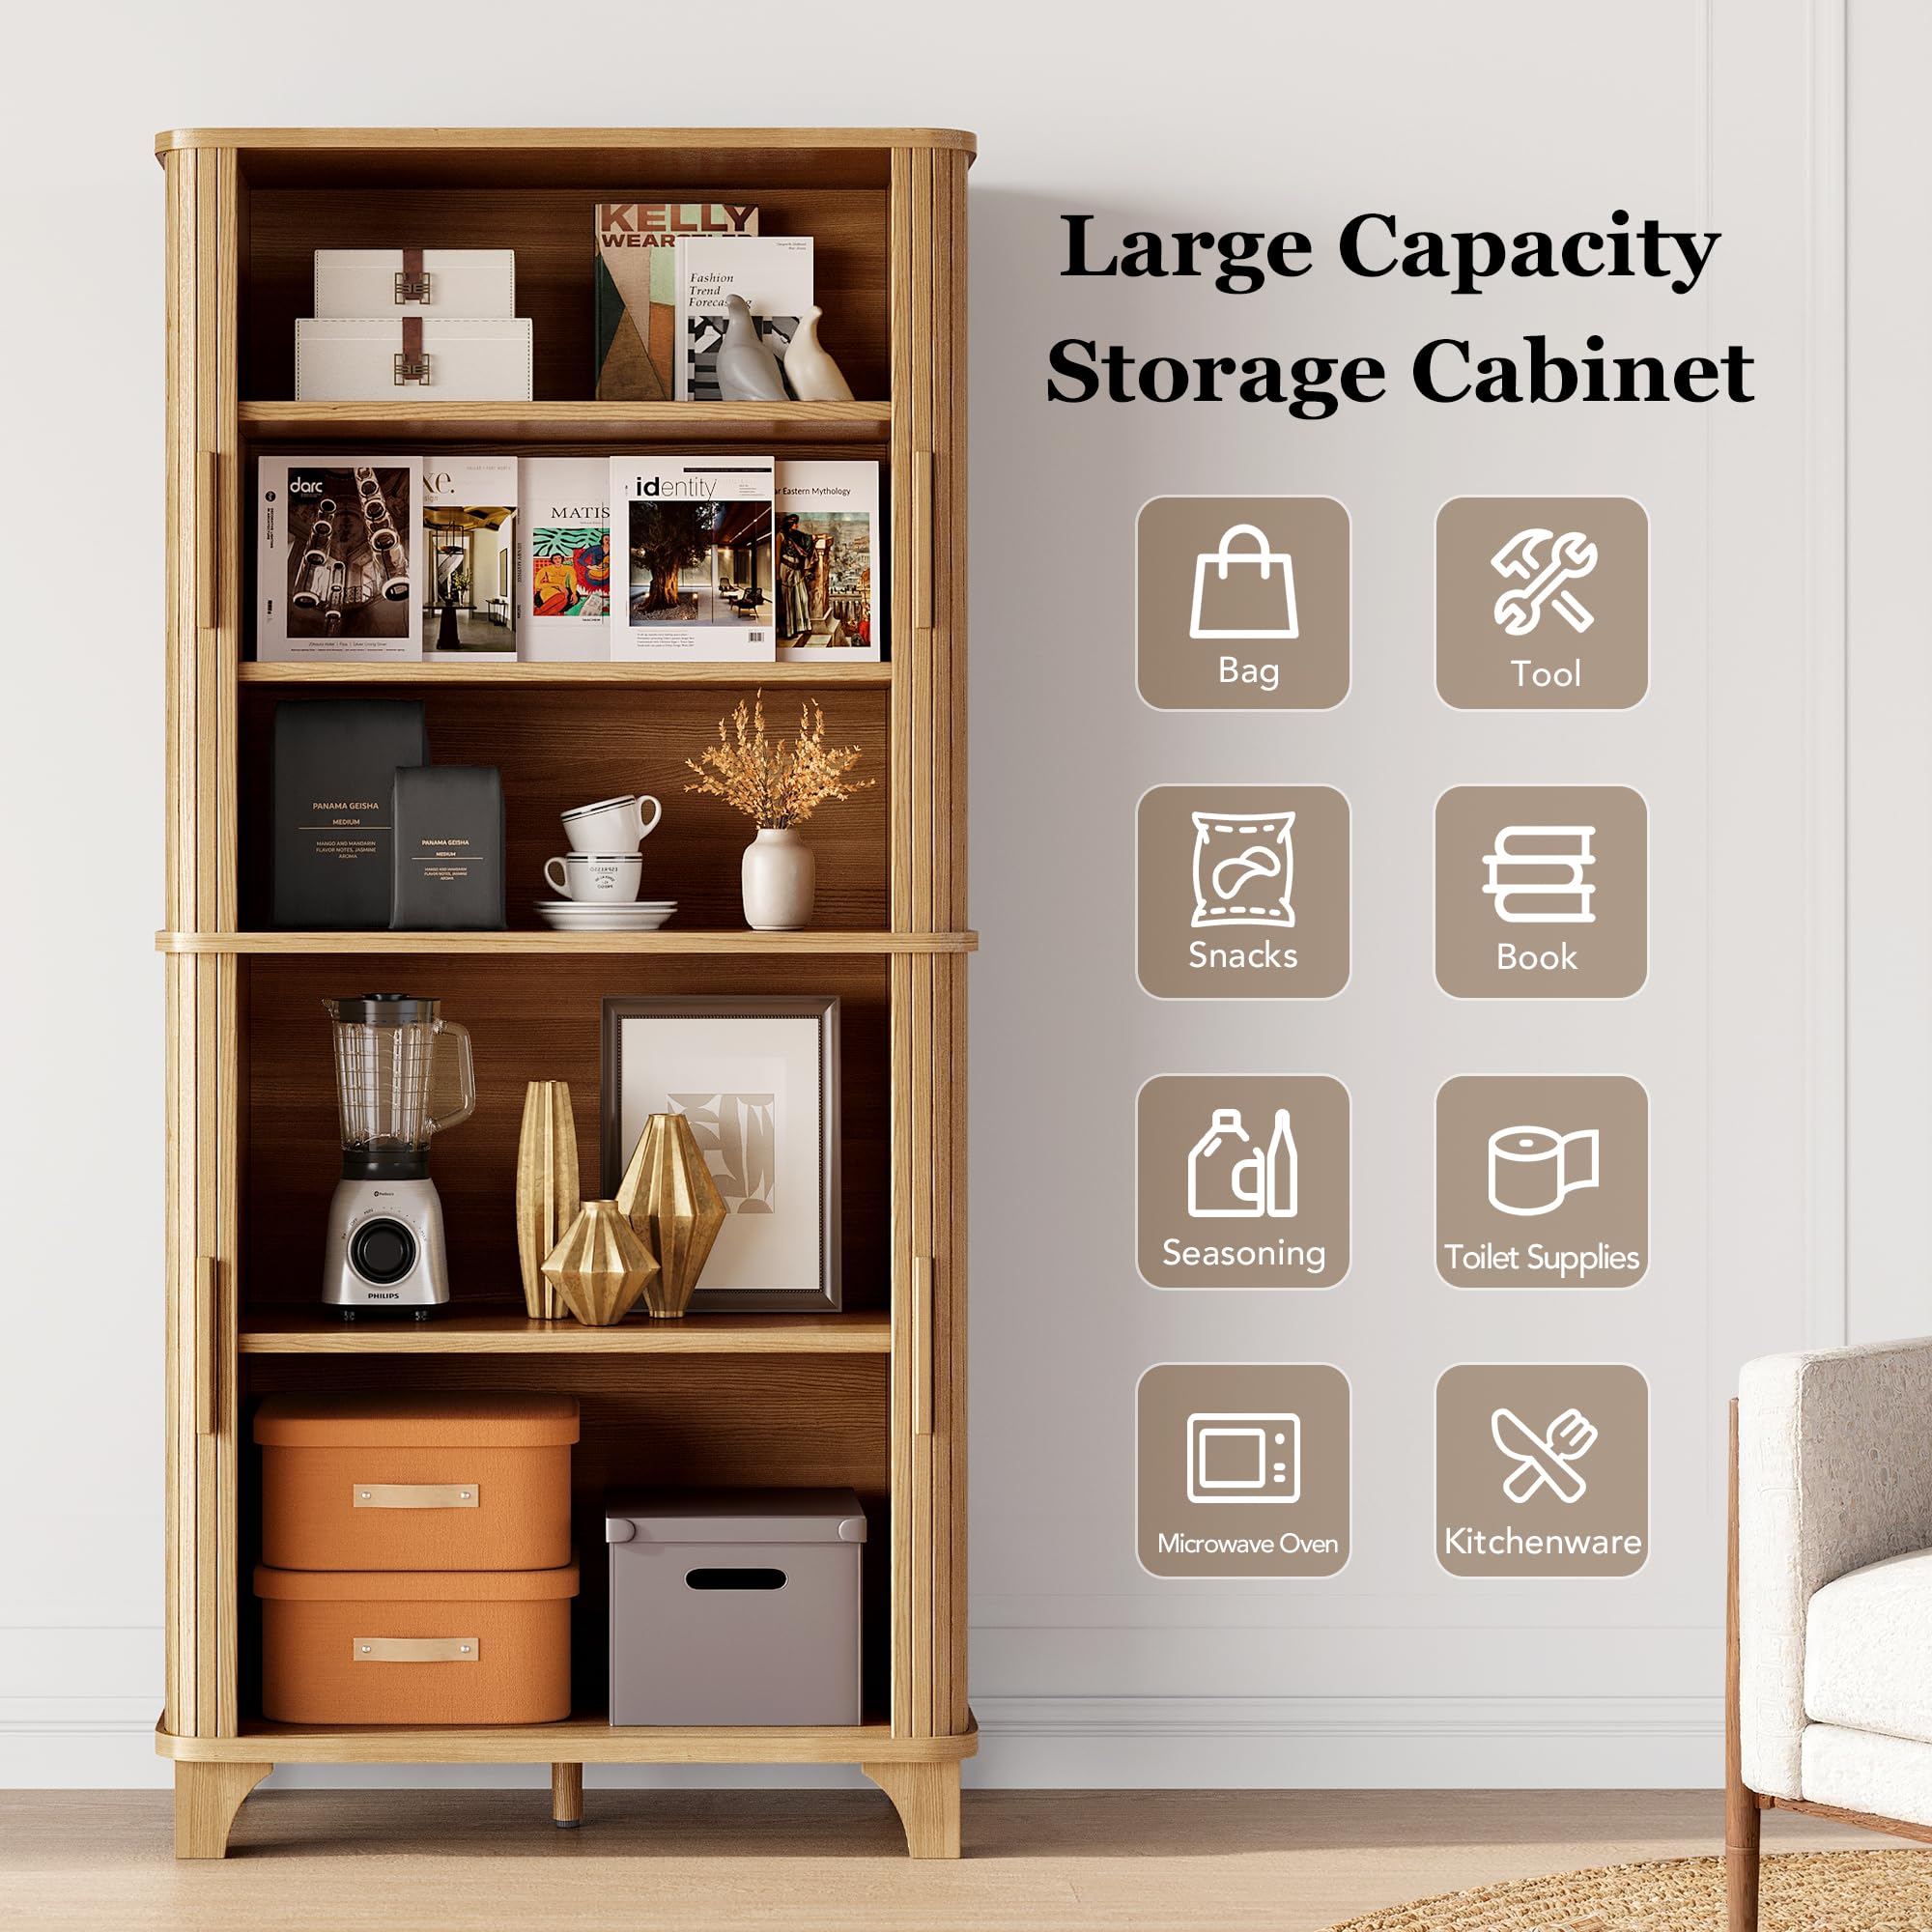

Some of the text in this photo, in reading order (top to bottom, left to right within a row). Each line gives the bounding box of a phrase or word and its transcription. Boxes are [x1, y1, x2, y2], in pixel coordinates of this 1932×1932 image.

[601, 204, 757, 232] KELLY
[690, 272, 734, 282] Fashion
[689, 286, 721, 295] Trend
[689, 297, 752, 309] Forecasg
[290, 476, 323, 493] darc
[637, 476, 718, 500] identity
[811, 487, 850, 497] Mythology
